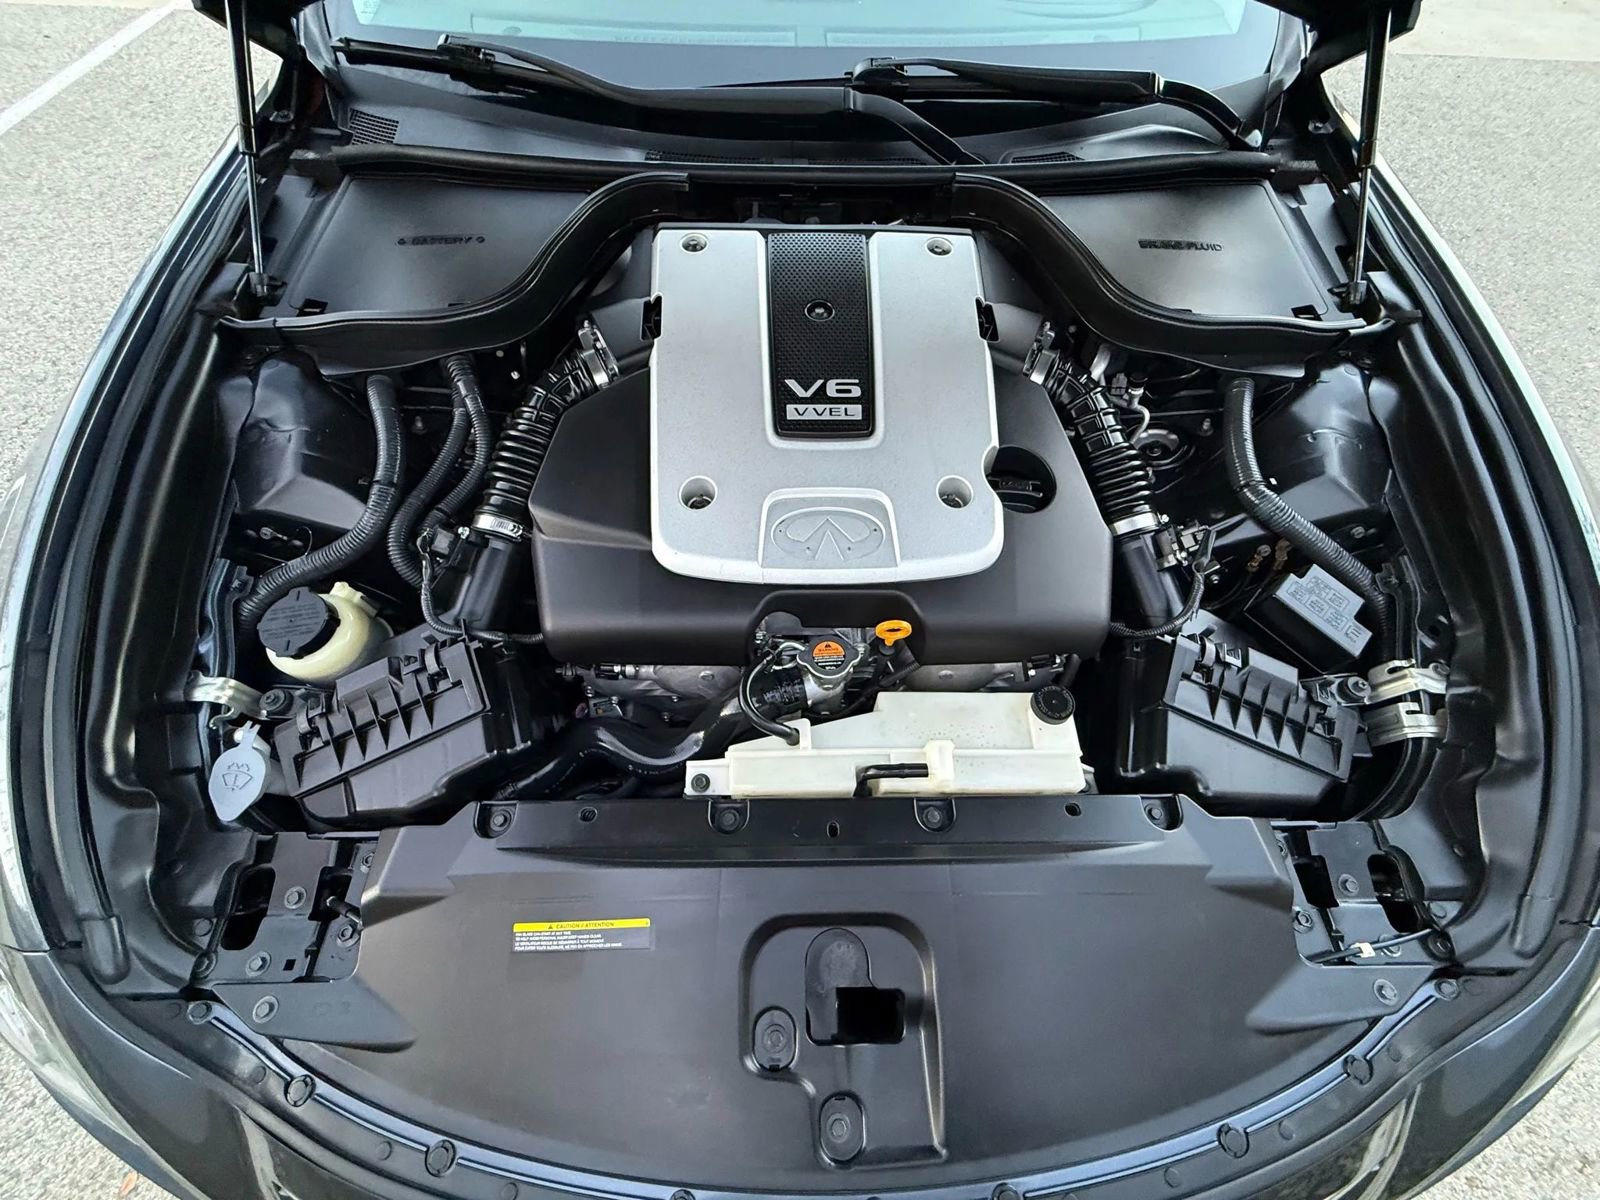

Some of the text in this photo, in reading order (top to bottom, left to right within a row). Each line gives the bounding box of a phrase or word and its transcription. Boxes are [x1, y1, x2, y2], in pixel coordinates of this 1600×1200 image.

[1185, 241, 1223, 252] FLUID
[784, 378, 862, 398] V6
[793, 407, 856, 417] VVEL
